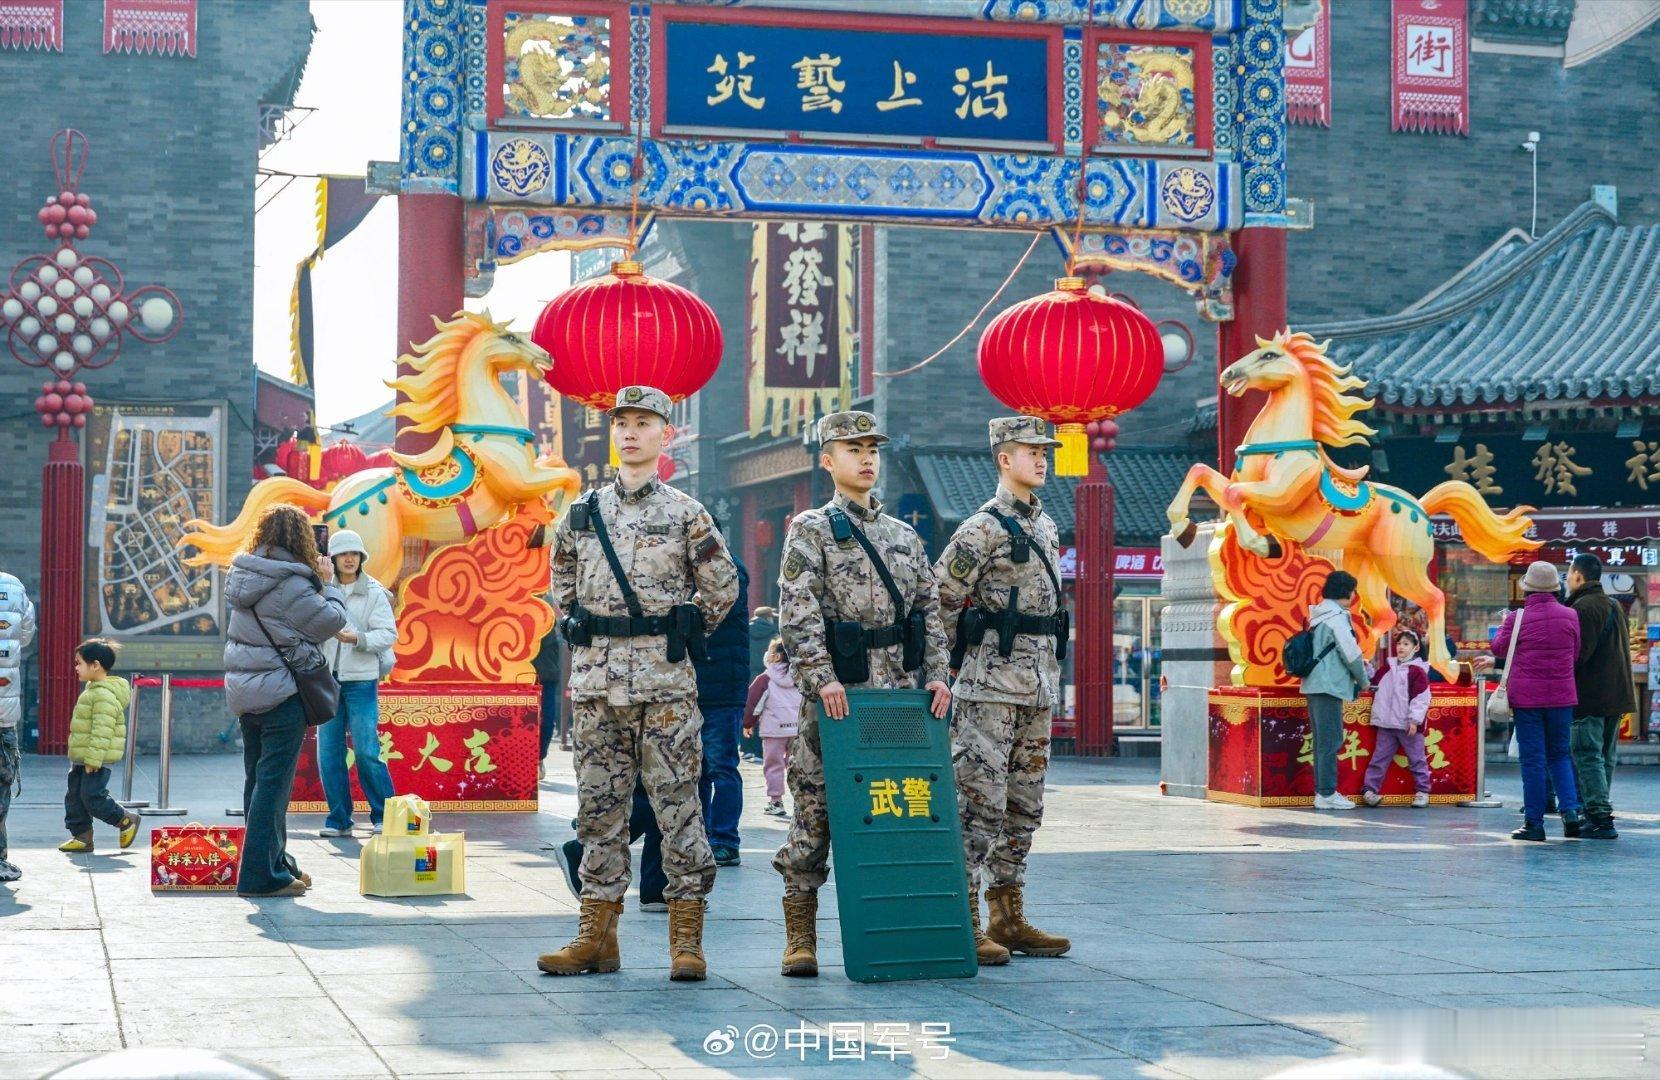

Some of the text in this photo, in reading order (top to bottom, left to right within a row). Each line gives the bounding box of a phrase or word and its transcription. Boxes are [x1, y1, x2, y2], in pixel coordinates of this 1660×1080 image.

[1409, 31, 1451, 72] 街
[1296, 727, 1451, 771] 年吉
[869, 777, 932, 818] 武警
